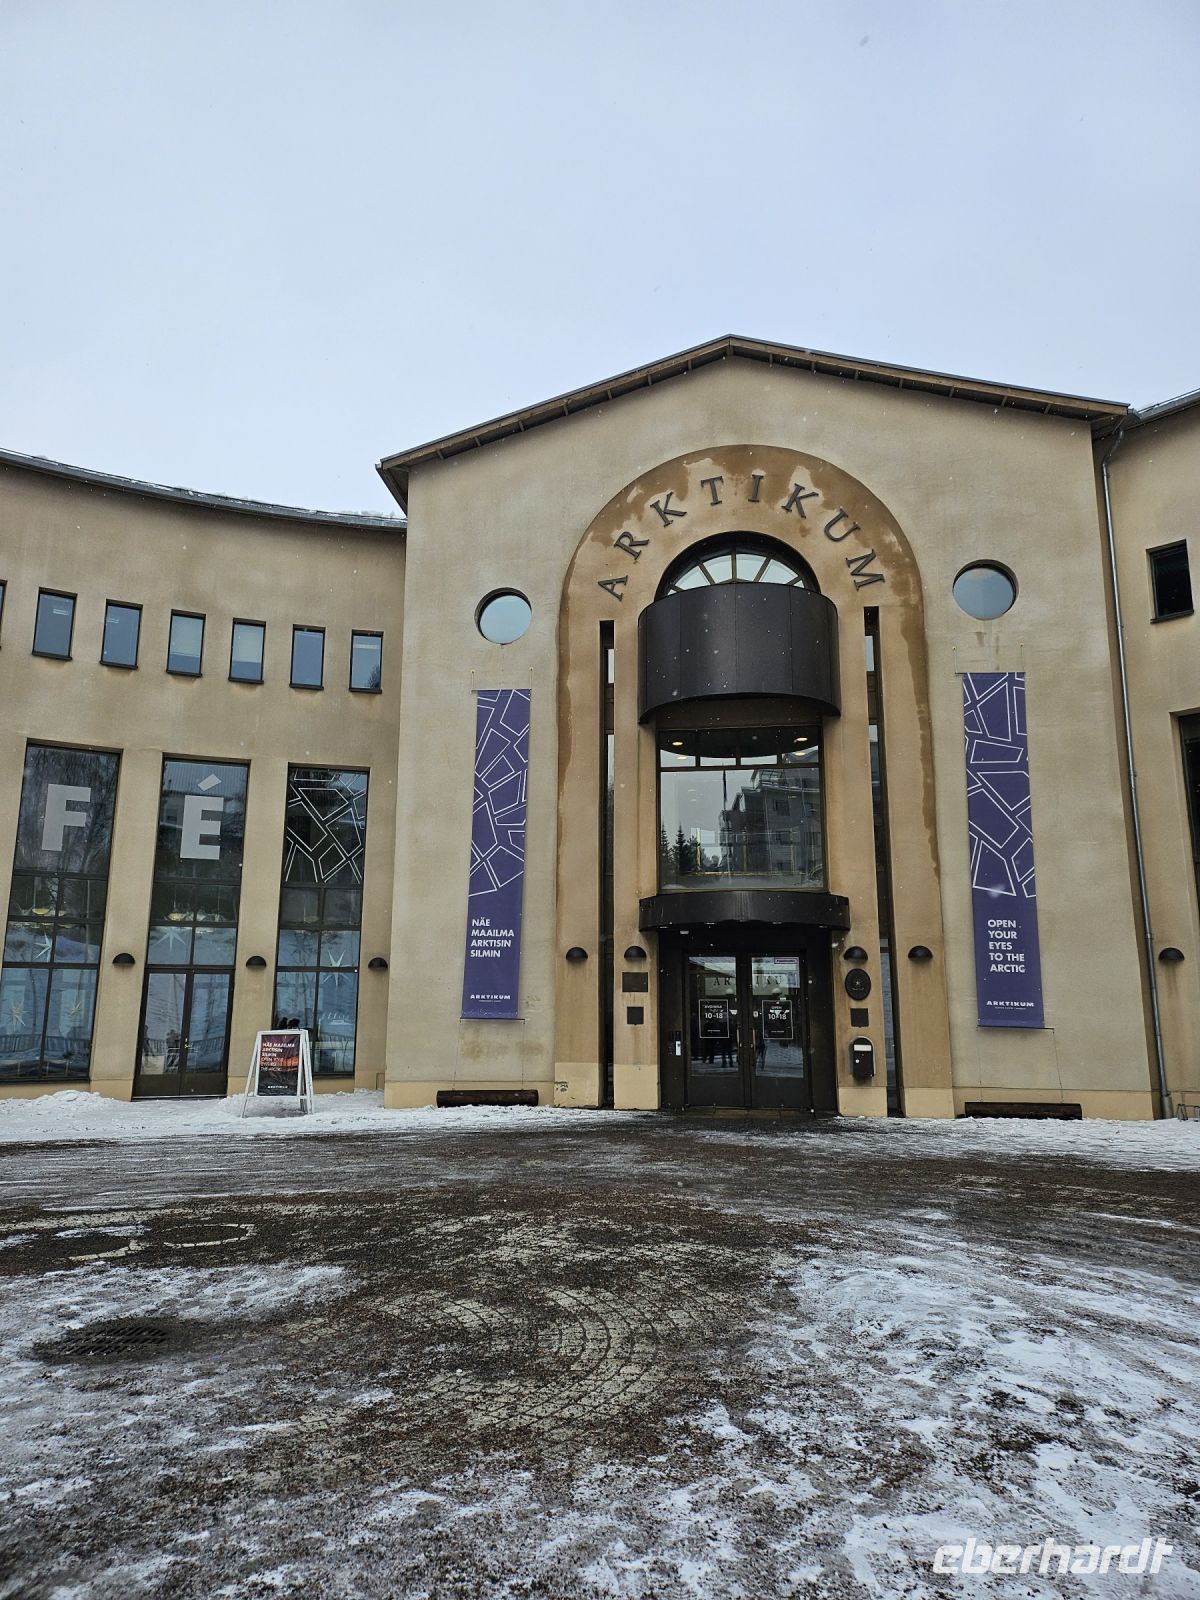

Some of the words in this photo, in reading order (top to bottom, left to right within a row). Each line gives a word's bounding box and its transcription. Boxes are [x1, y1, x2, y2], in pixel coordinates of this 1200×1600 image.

[598, 474, 885, 601] ARKTIKUM
[472, 917, 490, 926] NÄE
[987, 920, 1016, 928] OPEN
[471, 929, 514, 937] MAAILMA
[988, 931, 1017, 939] YOUR
[989, 942, 1012, 950] EYES
[989, 953, 1003, 961] TO
[1006, 953, 1025, 961] THE
[990, 964, 1025, 973] ARCTIC
